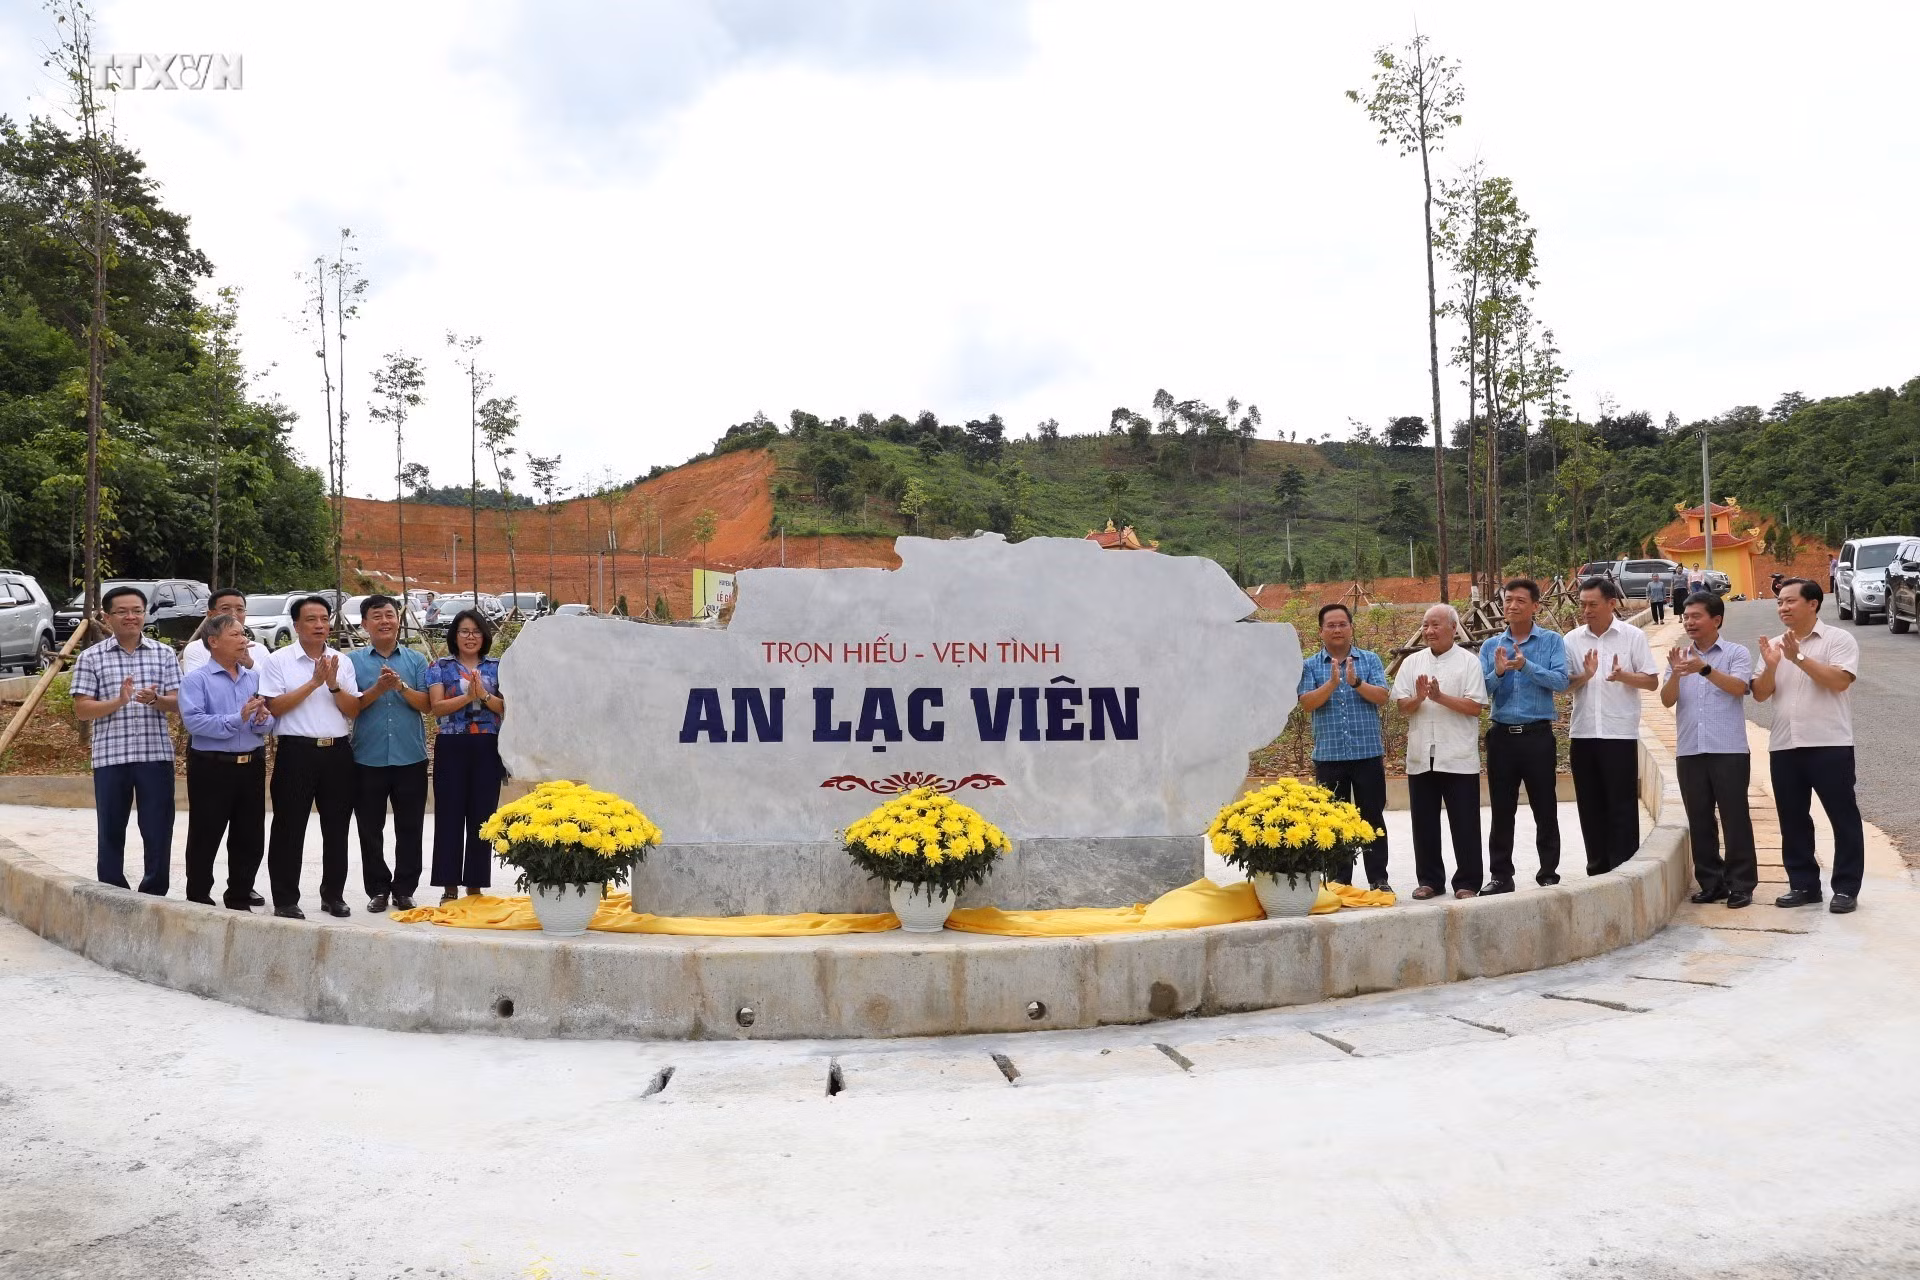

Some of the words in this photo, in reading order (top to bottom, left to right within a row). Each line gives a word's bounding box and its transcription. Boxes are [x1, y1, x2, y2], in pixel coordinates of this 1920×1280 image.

[761, 641, 833, 668] TRỌN
[843, 633, 907, 663] HIẾU
[932, 641, 987, 668] VẸN
[996, 637, 1060, 663] TÌNH
[679, 687, 785, 743] AN
[812, 687, 944, 752] LẠC
[970, 675, 1139, 742] VIÊN
